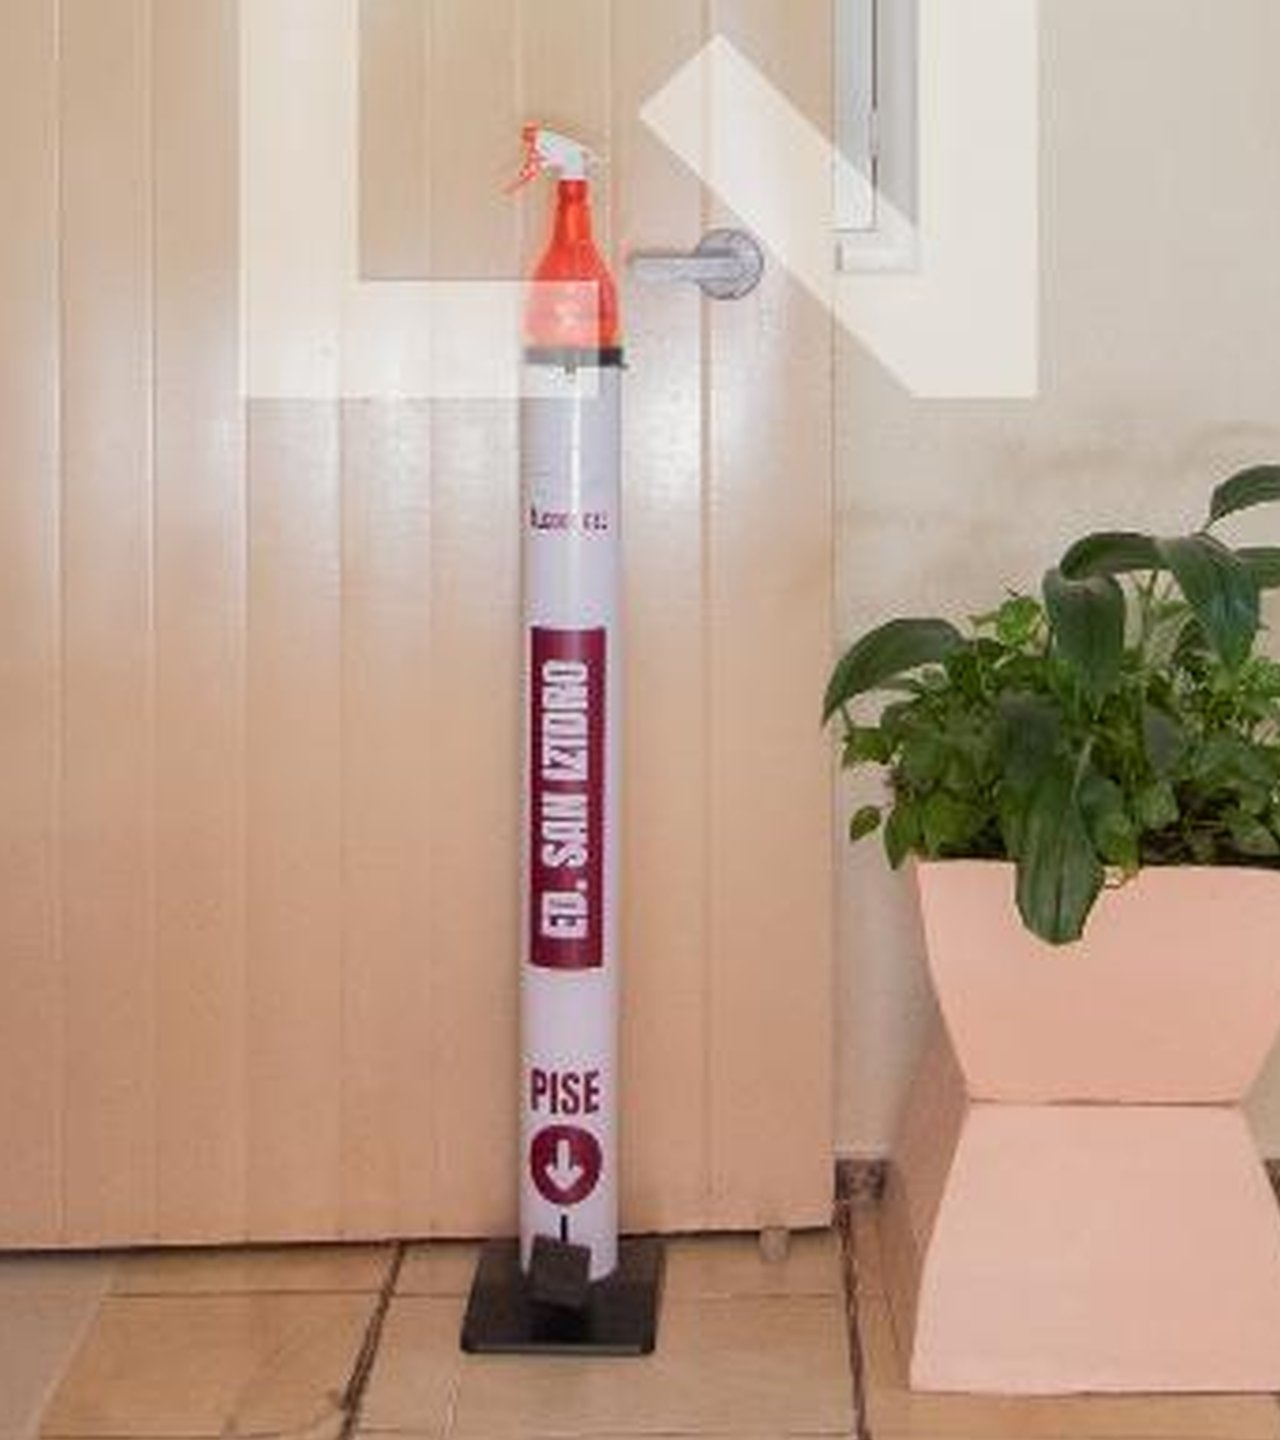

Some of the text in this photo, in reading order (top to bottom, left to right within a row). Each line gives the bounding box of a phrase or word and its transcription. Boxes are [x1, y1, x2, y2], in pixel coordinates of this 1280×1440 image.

[540, 792, 589, 868] SAN
[540, 878, 589, 939] ED.
[531, 1069, 600, 1115] PISE
